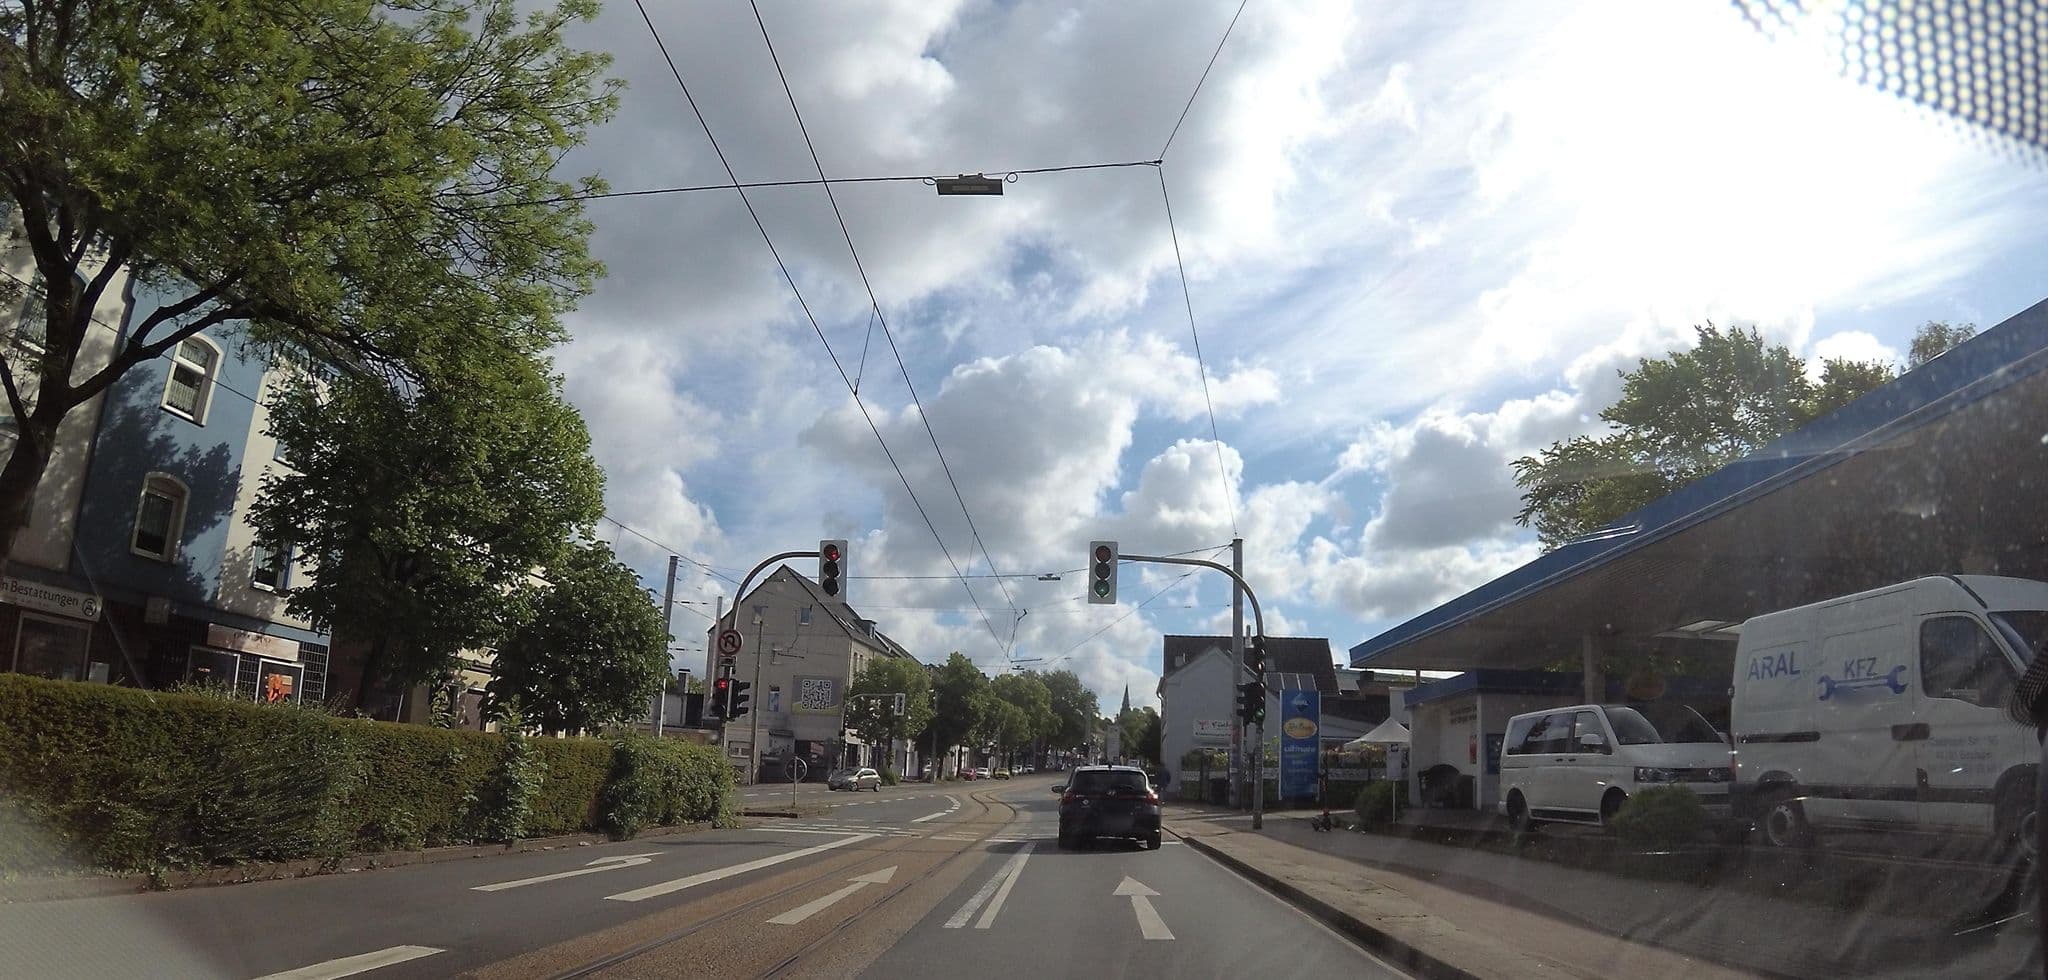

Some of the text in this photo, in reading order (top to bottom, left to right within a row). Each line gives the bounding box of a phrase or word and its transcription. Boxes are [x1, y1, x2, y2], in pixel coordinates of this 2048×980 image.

[11, 580, 79, 607] Bestattungen
[1747, 651, 1801, 680] ARAL
[1844, 657, 1878, 678] KFZ
